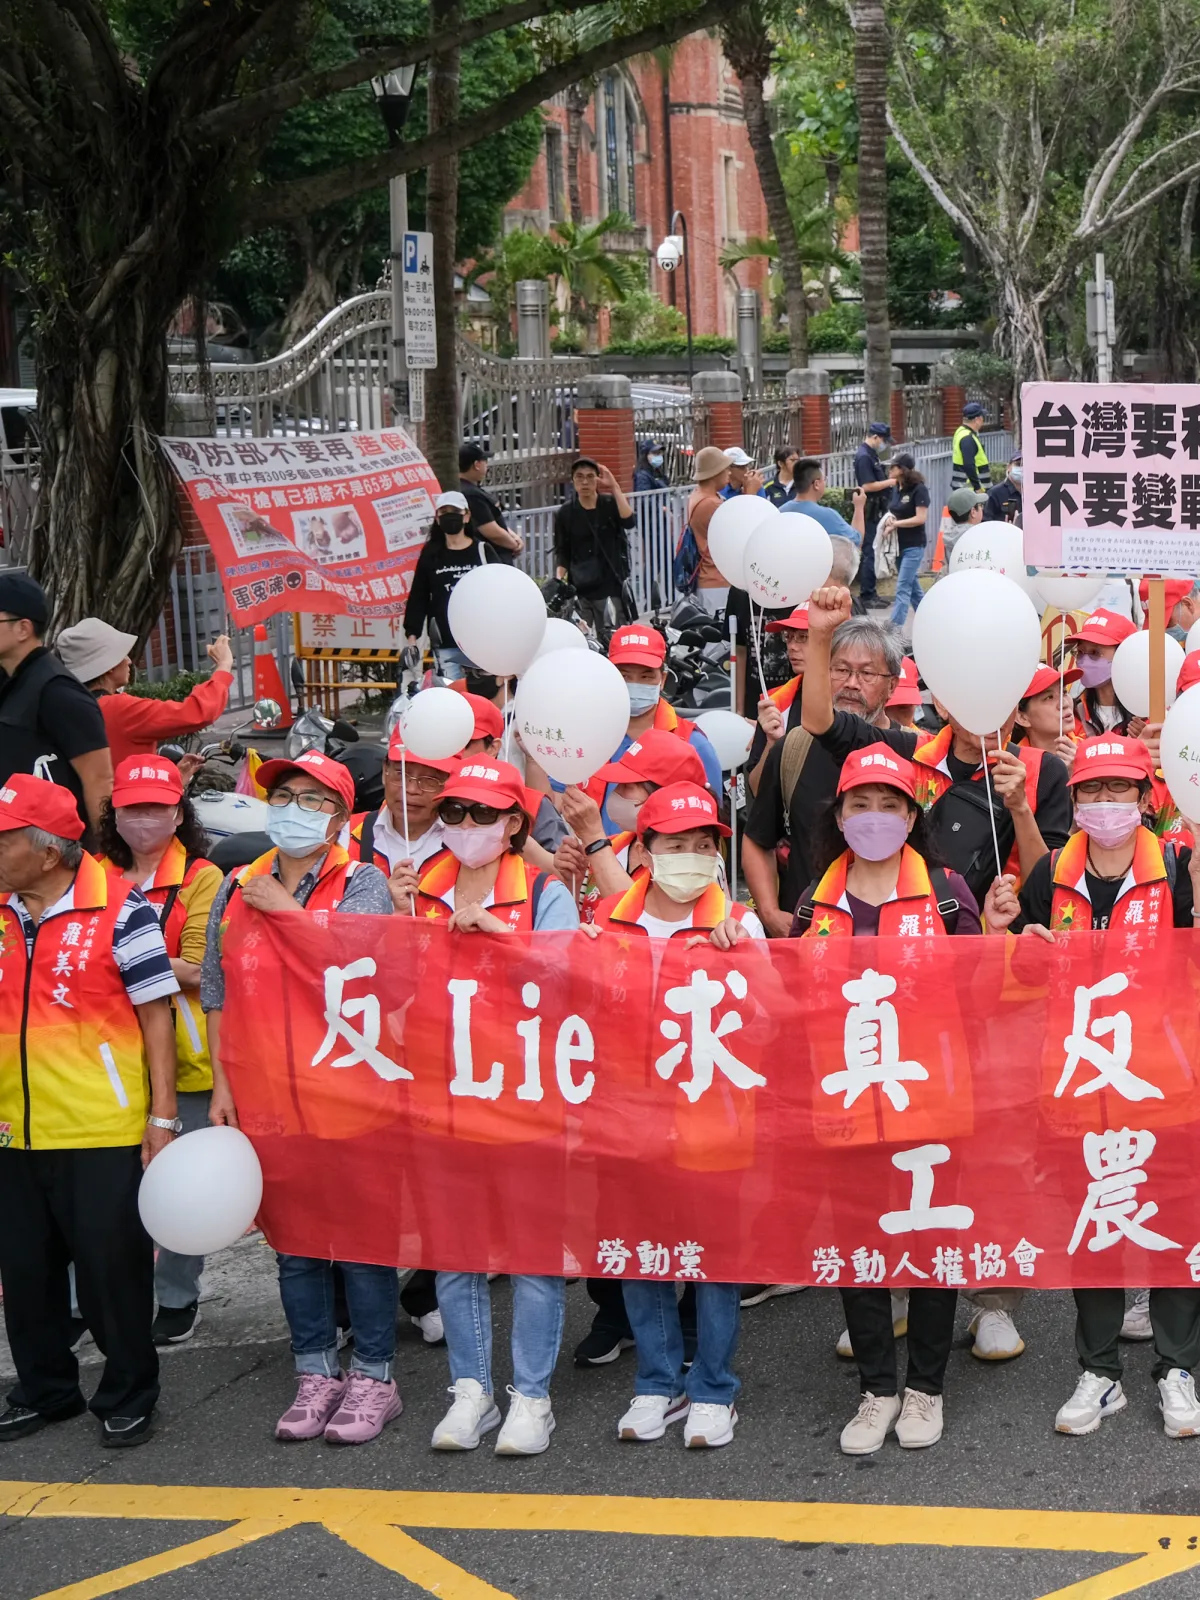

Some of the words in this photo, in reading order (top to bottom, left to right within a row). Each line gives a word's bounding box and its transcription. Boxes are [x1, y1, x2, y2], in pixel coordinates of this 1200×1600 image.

[406, 239, 416, 268] P
[620, 634, 650, 647] 勞動黨
[524, 721, 565, 742] 反Lie求真
[536, 743, 585, 759] 反戰求生
[1085, 742, 1125, 759] 勞動黨
[459, 764, 501, 782] 勞動黨
[860, 753, 899, 772] 勞動黨
[129, 766, 171, 782] 勞動黨
[670, 795, 713, 813] 勞動黨
[78, 916, 98, 972] 新竹縣議員
[1119, 900, 1146, 991] 羅美文
[50, 922, 85, 1010] 羅美文
[898, 914, 923, 1003] 羅美文
[311, 956, 931, 1113] 反Lie求真
[597, 1238, 708, 1281] 勞動黨
[812, 1240, 1045, 1285] 勞動人權協會
